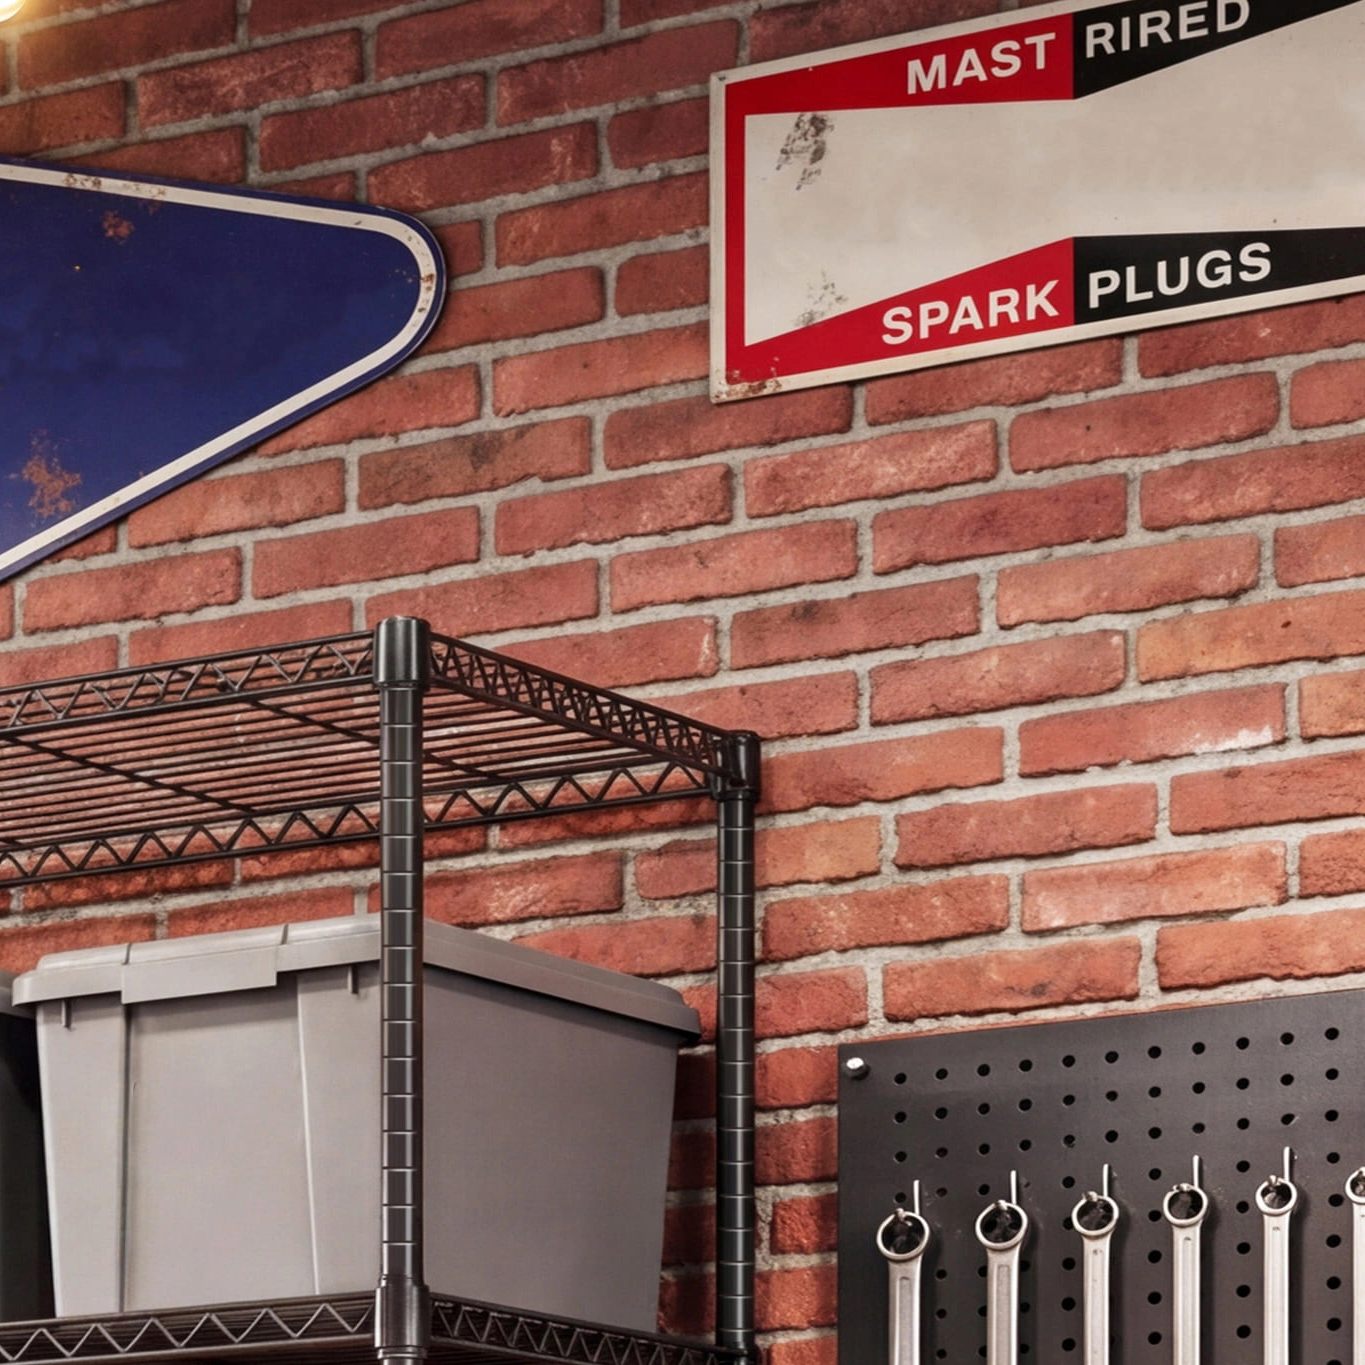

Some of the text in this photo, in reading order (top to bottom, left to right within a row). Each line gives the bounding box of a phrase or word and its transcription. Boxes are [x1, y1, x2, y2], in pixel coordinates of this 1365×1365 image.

[907, 0, 1250, 95] MAST RIRED
[881, 242, 1272, 346] SPARK PLUGS
